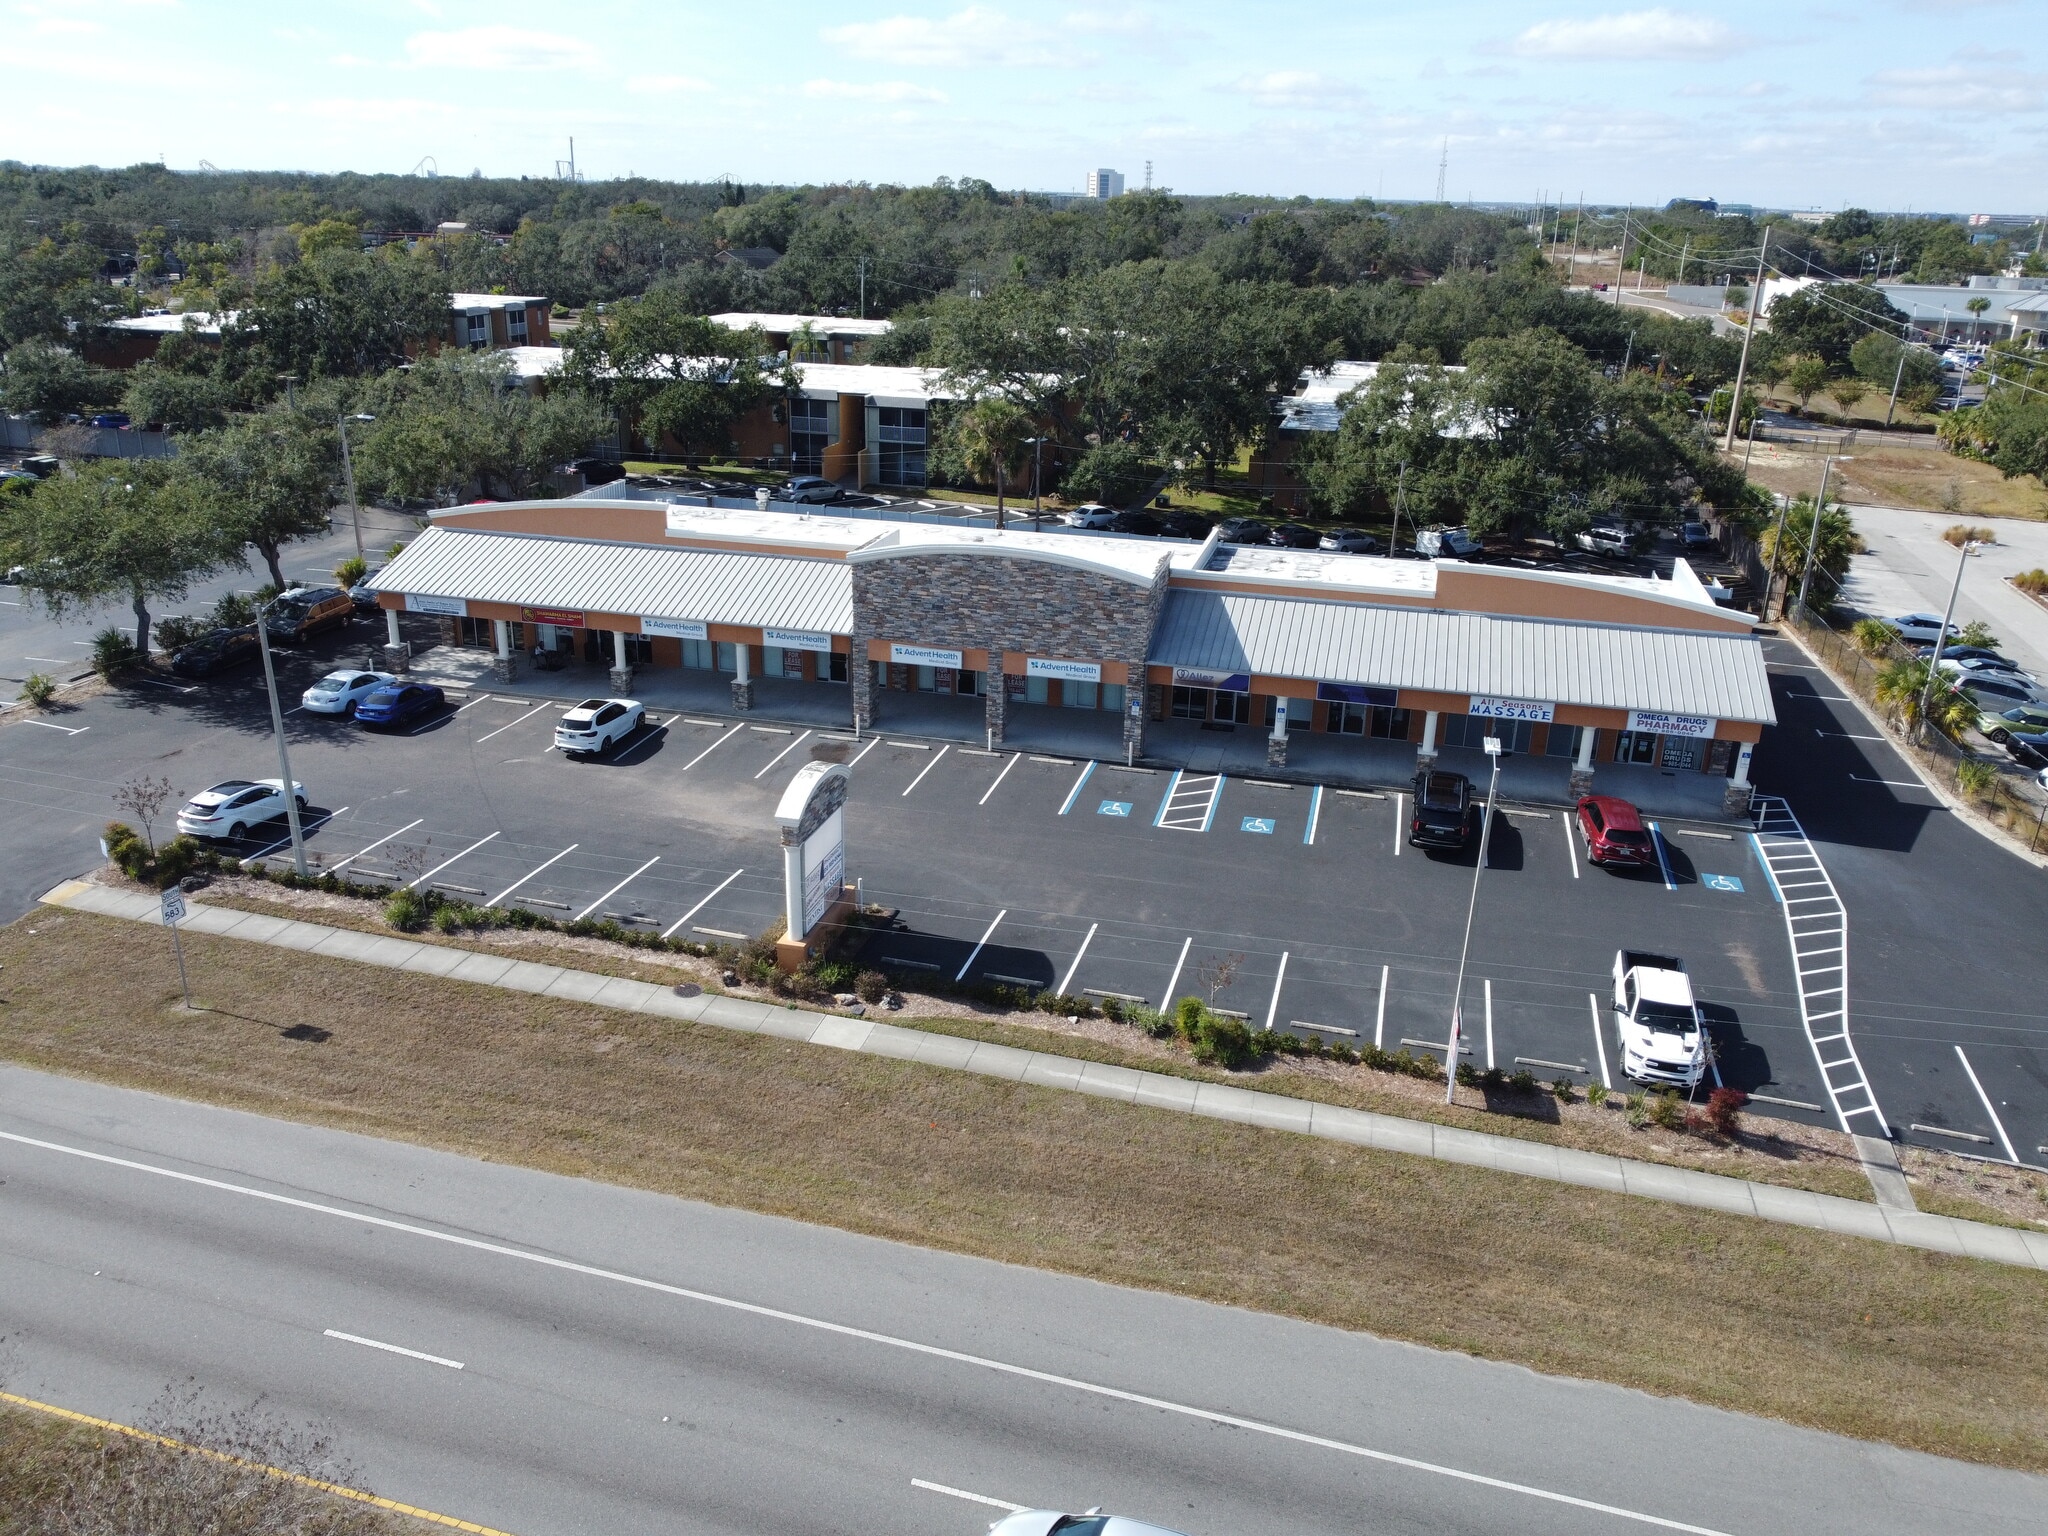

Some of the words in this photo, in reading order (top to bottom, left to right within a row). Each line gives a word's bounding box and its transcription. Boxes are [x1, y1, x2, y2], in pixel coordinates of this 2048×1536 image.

[653, 620, 703, 632] AdventHealth
[776, 632, 827, 644] AdventHealth
[904, 648, 958, 660] AdventHealth
[1040, 662, 1097, 674] AdventHealth
[1481, 698, 1495, 706] All
[1501, 700, 1543, 711] Seasons
[1470, 704, 1551, 721] MASSAGE
[1637, 712, 1669, 722] OMEGA
[1676, 716, 1708, 726] DRUGS
[1636, 719, 1707, 733] PHARMACY
[1664, 749, 1692, 757] OMEGA
[165, 907, 180, 920] 583
